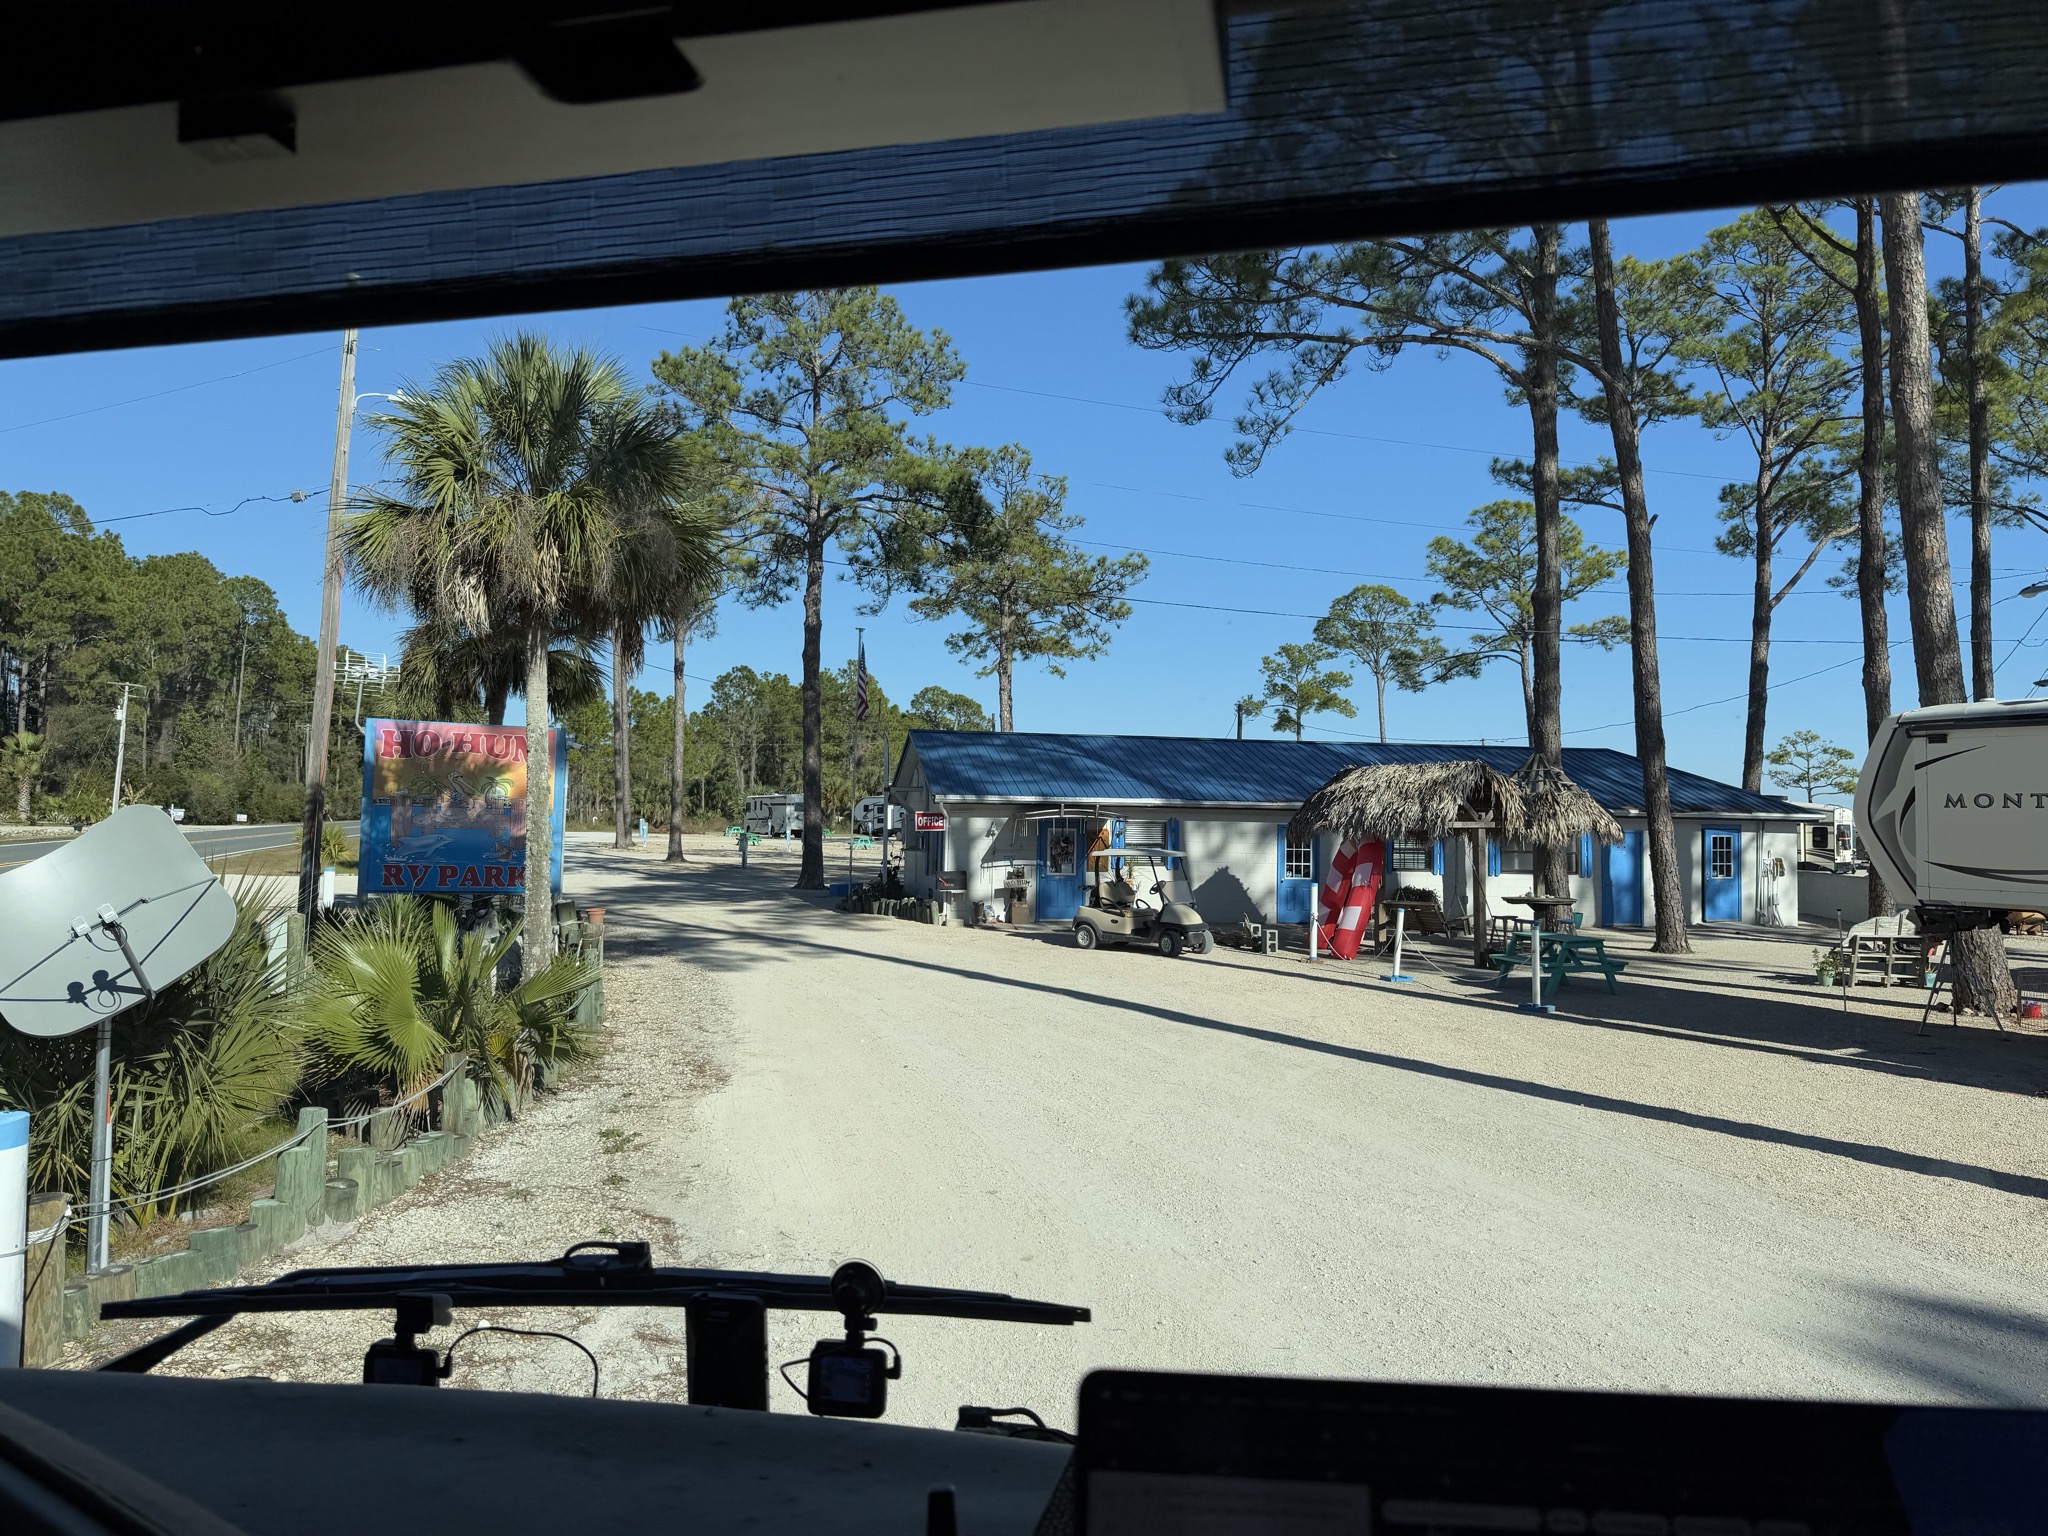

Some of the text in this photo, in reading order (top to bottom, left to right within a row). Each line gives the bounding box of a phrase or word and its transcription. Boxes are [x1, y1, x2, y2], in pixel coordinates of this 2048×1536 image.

[1944, 793, 2048, 809] MONT
[917, 816, 944, 827] OFFICE
[381, 864, 526, 888] RV PARK
